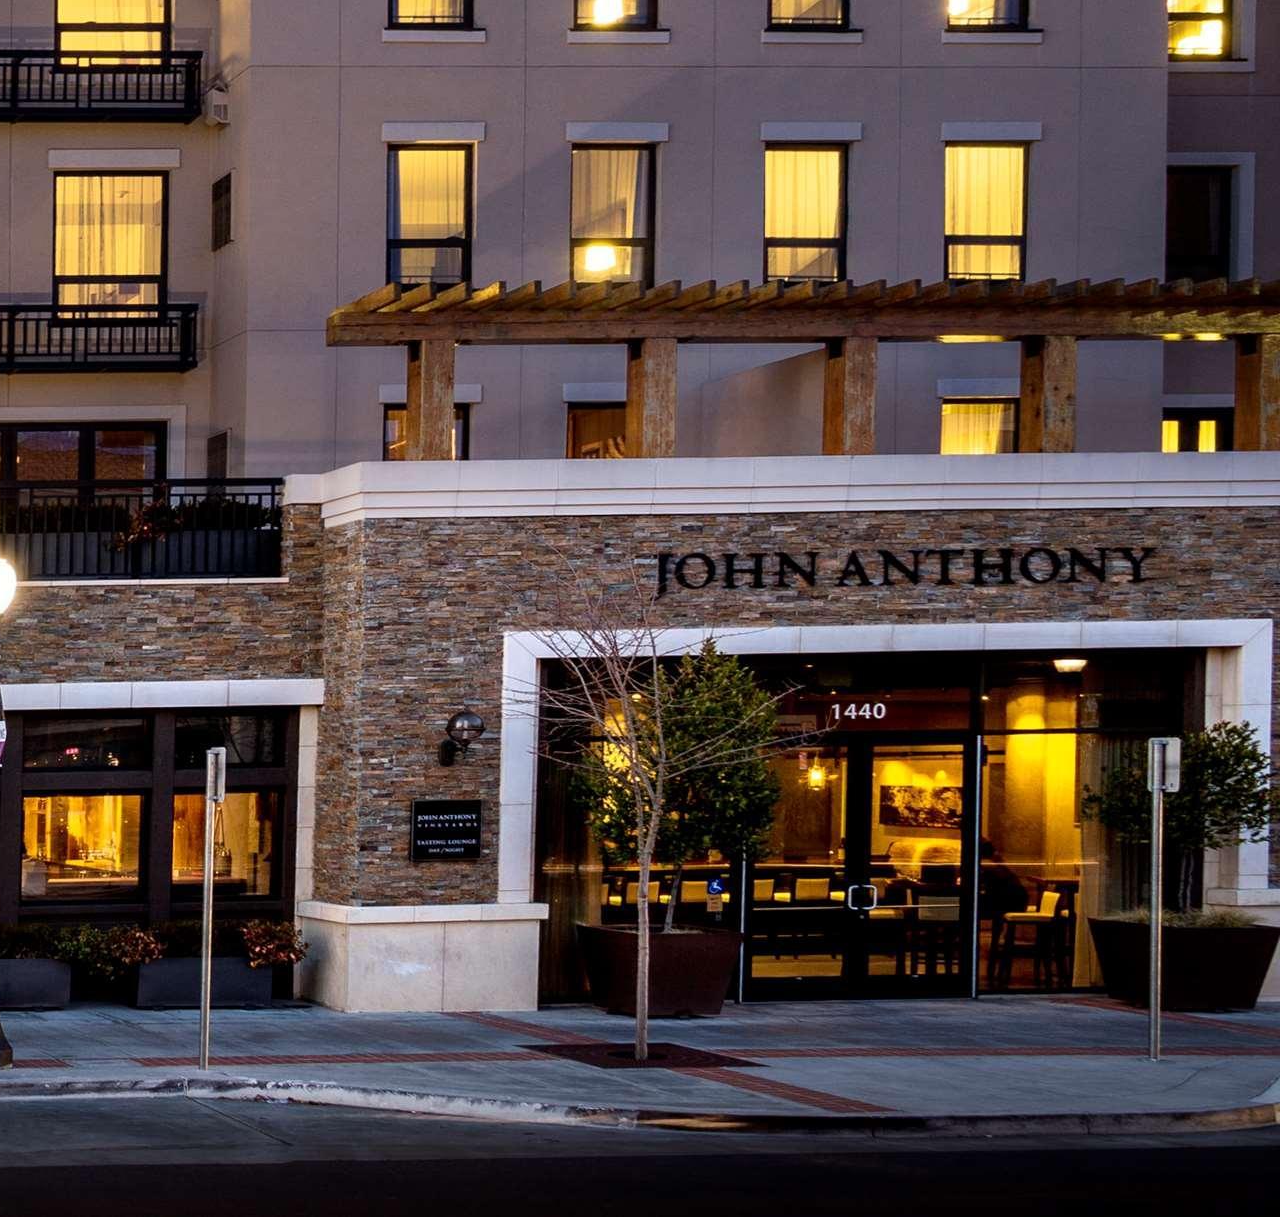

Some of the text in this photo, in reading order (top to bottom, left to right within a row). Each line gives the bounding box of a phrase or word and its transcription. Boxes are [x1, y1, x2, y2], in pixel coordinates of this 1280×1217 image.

[654, 547, 1158, 599] JOHN ANTHONY
[831, 702, 887, 720] 1440
[417, 814, 438, 822] JOHN
